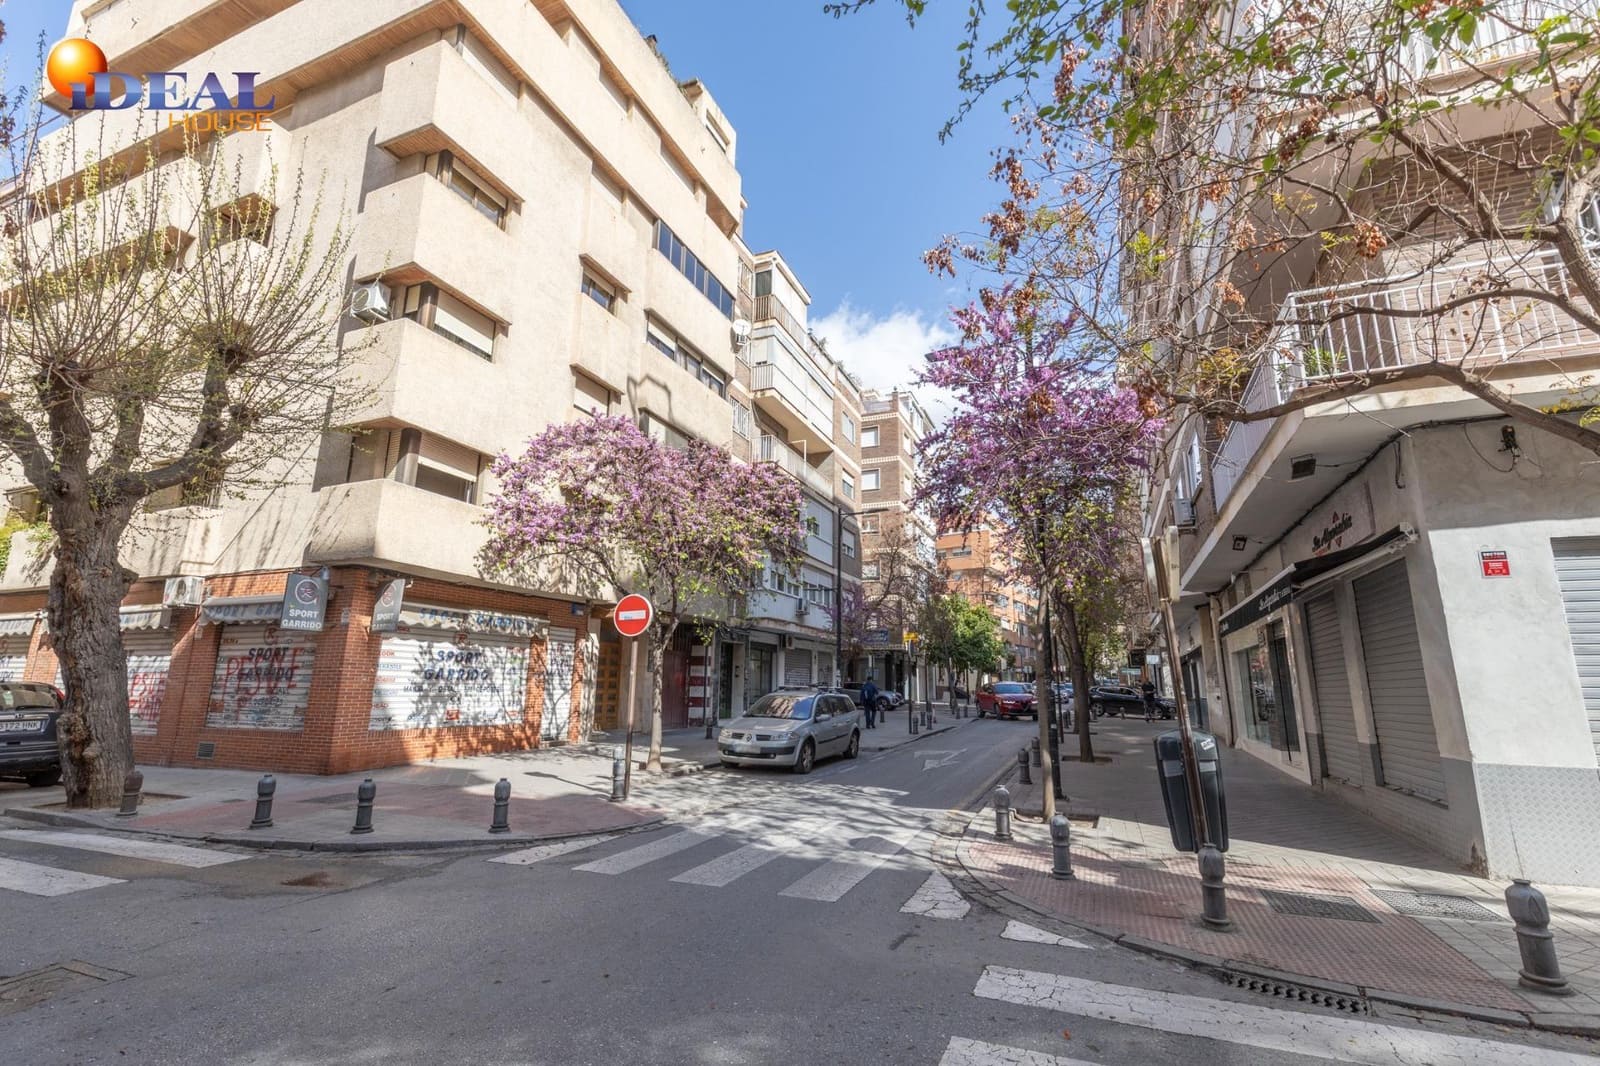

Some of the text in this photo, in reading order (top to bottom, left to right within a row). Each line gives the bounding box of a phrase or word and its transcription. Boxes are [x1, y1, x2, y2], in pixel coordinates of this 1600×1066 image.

[288, 608, 320, 619] SPORT
[376, 612, 395, 621] SPORT
[282, 618, 322, 630] GARRIDO
[248, 646, 290, 662] SPORT
[437, 650, 482, 665] SPORT
[424, 668, 491, 682] GARRIDO
